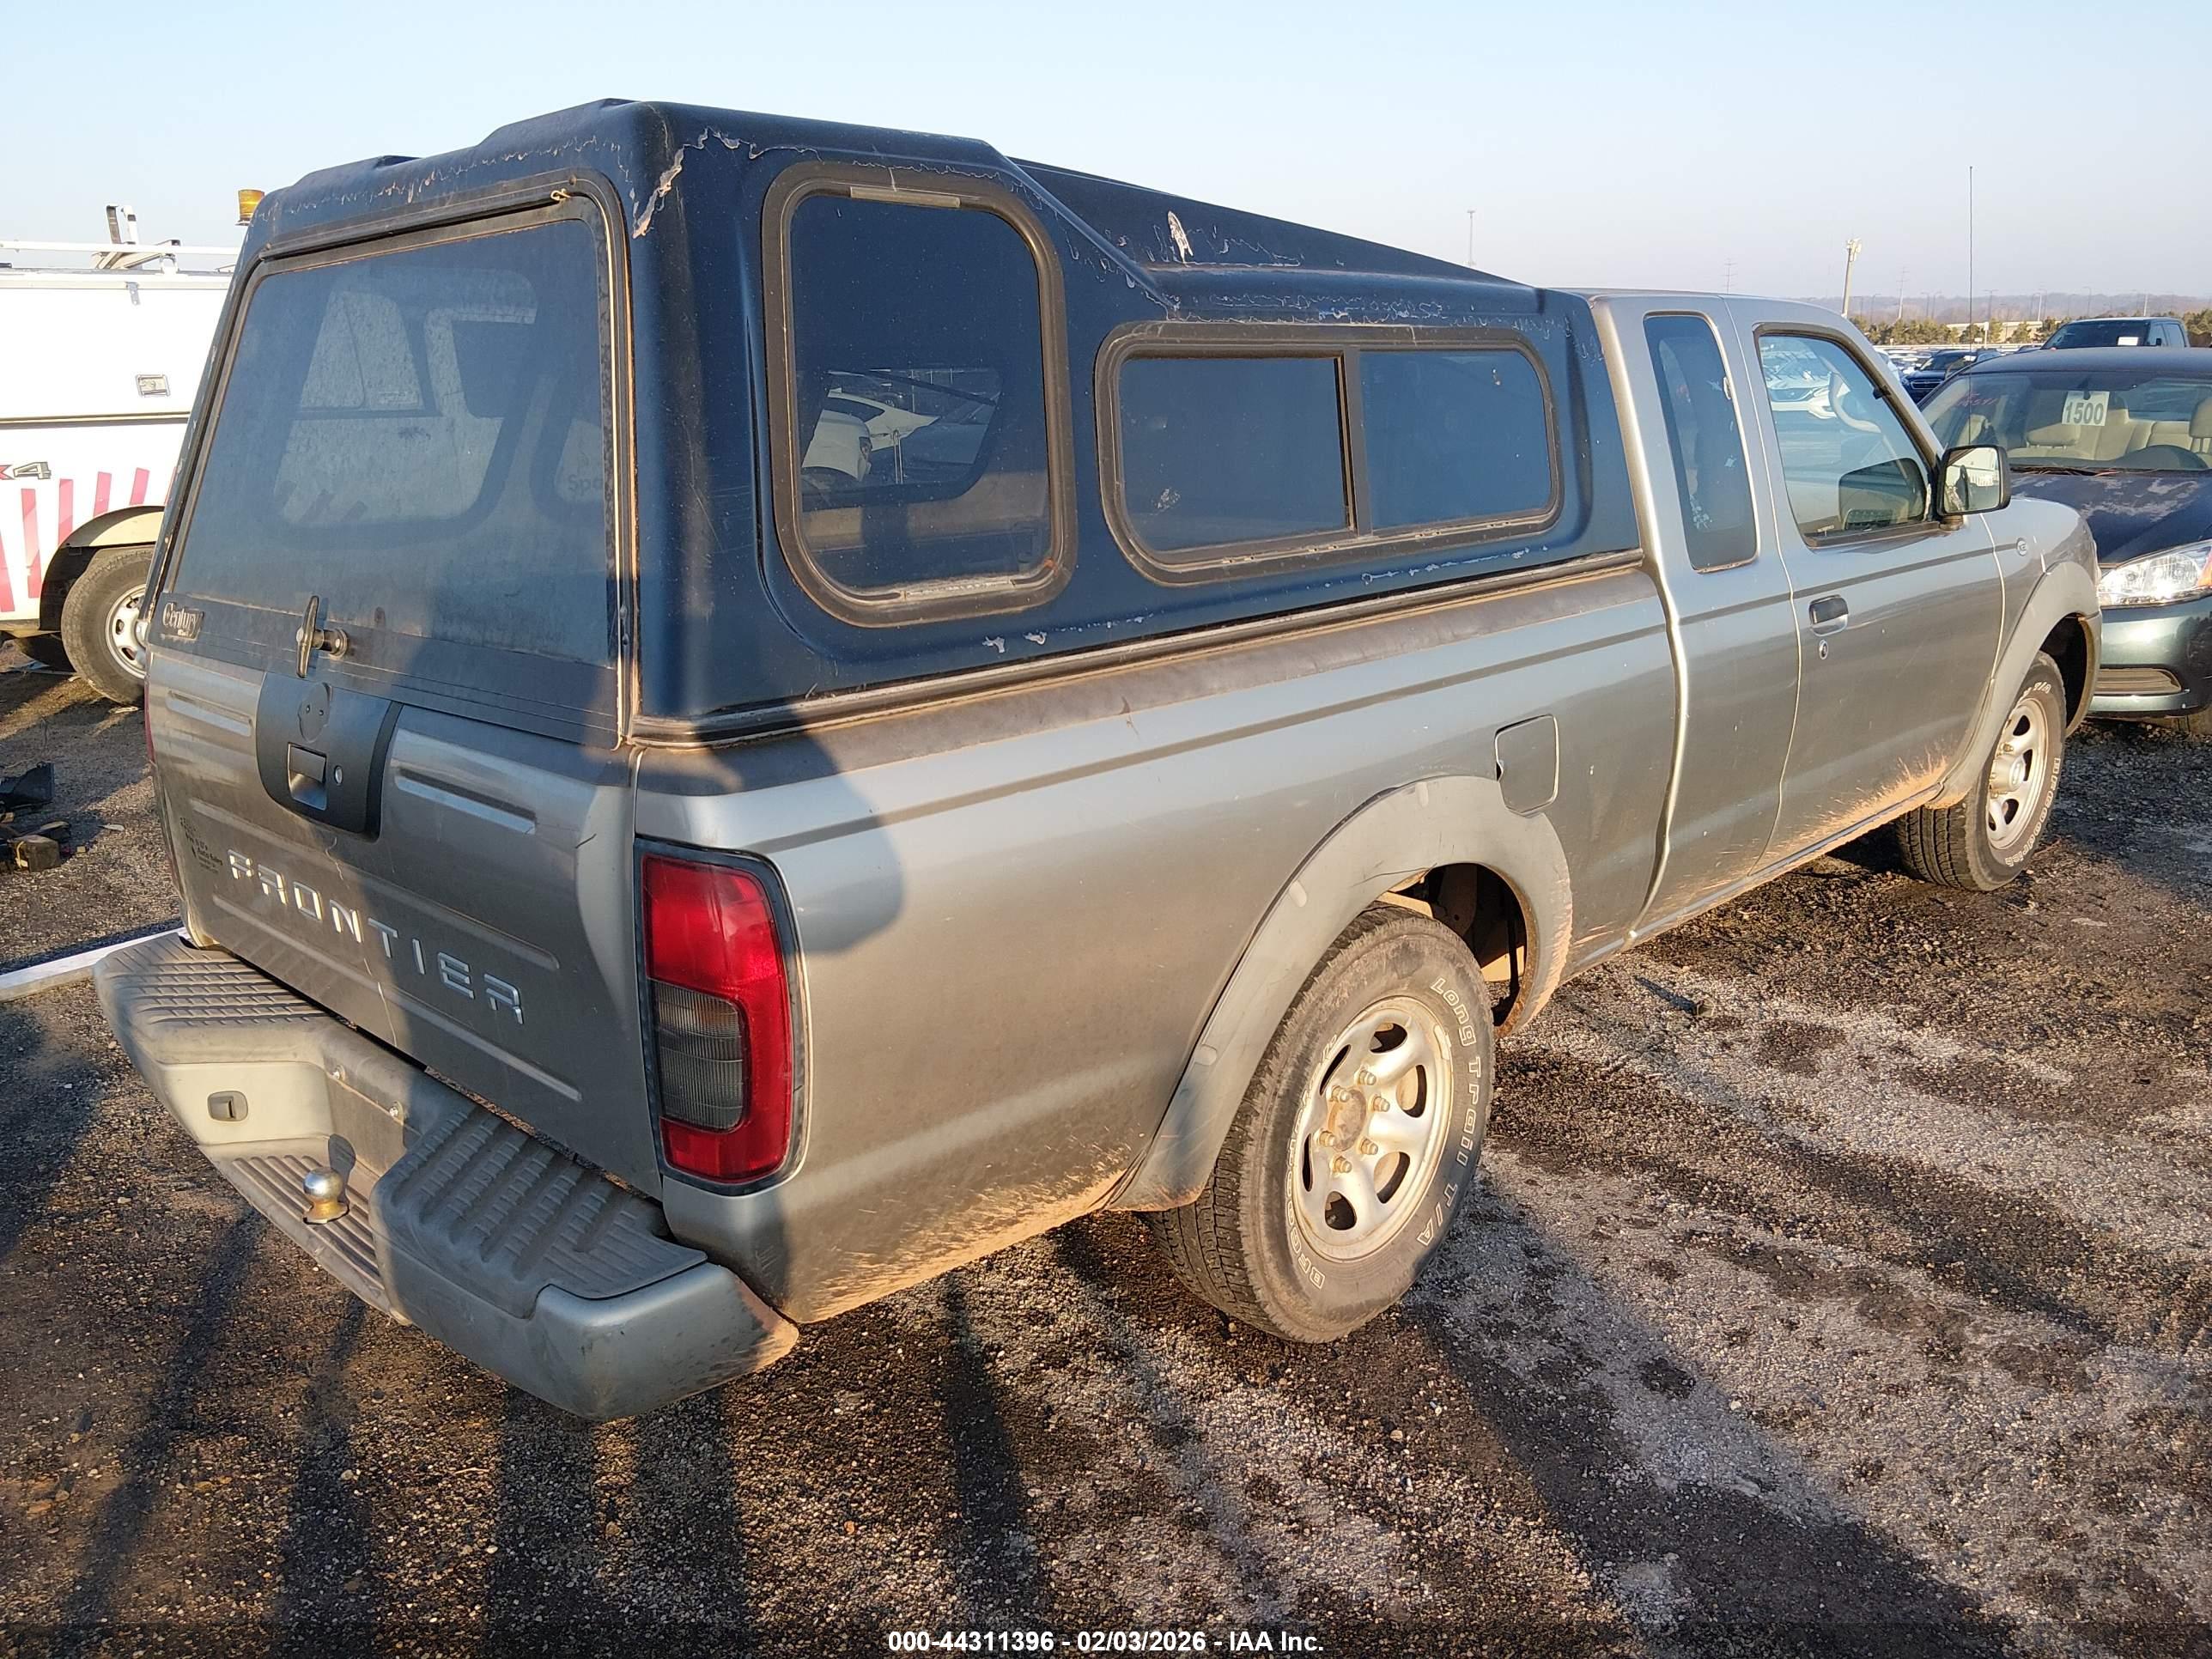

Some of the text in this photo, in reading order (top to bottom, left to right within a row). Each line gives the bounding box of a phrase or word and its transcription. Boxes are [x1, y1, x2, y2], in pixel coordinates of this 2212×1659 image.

[2066, 402, 2104, 424] 1500
[163, 603, 199, 637] Century
[228, 848, 525, 1024] FRONTIER
[1417, 977, 1482, 1246] Long Trail T/A
